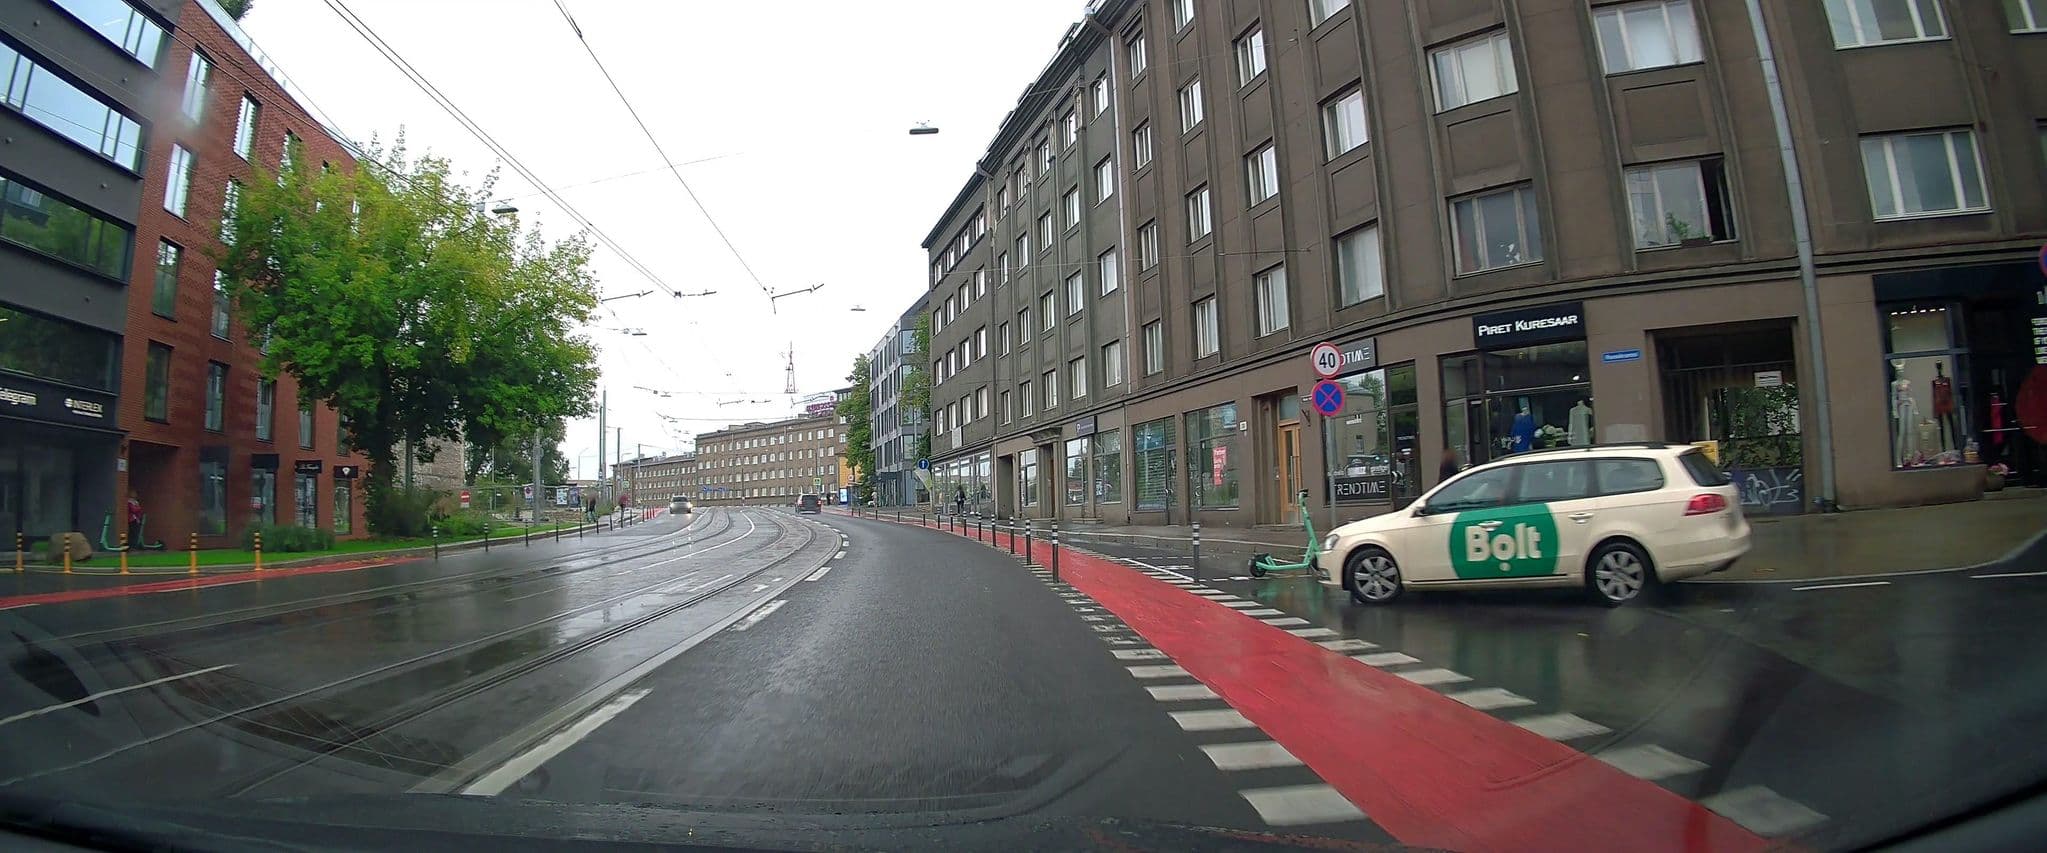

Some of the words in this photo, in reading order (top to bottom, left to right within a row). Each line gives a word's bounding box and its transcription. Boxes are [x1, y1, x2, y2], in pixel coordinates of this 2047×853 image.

[1319, 352, 1336, 368] 40
[0, 387, 37, 405] elegram
[1465, 522, 1542, 562] Bolt
